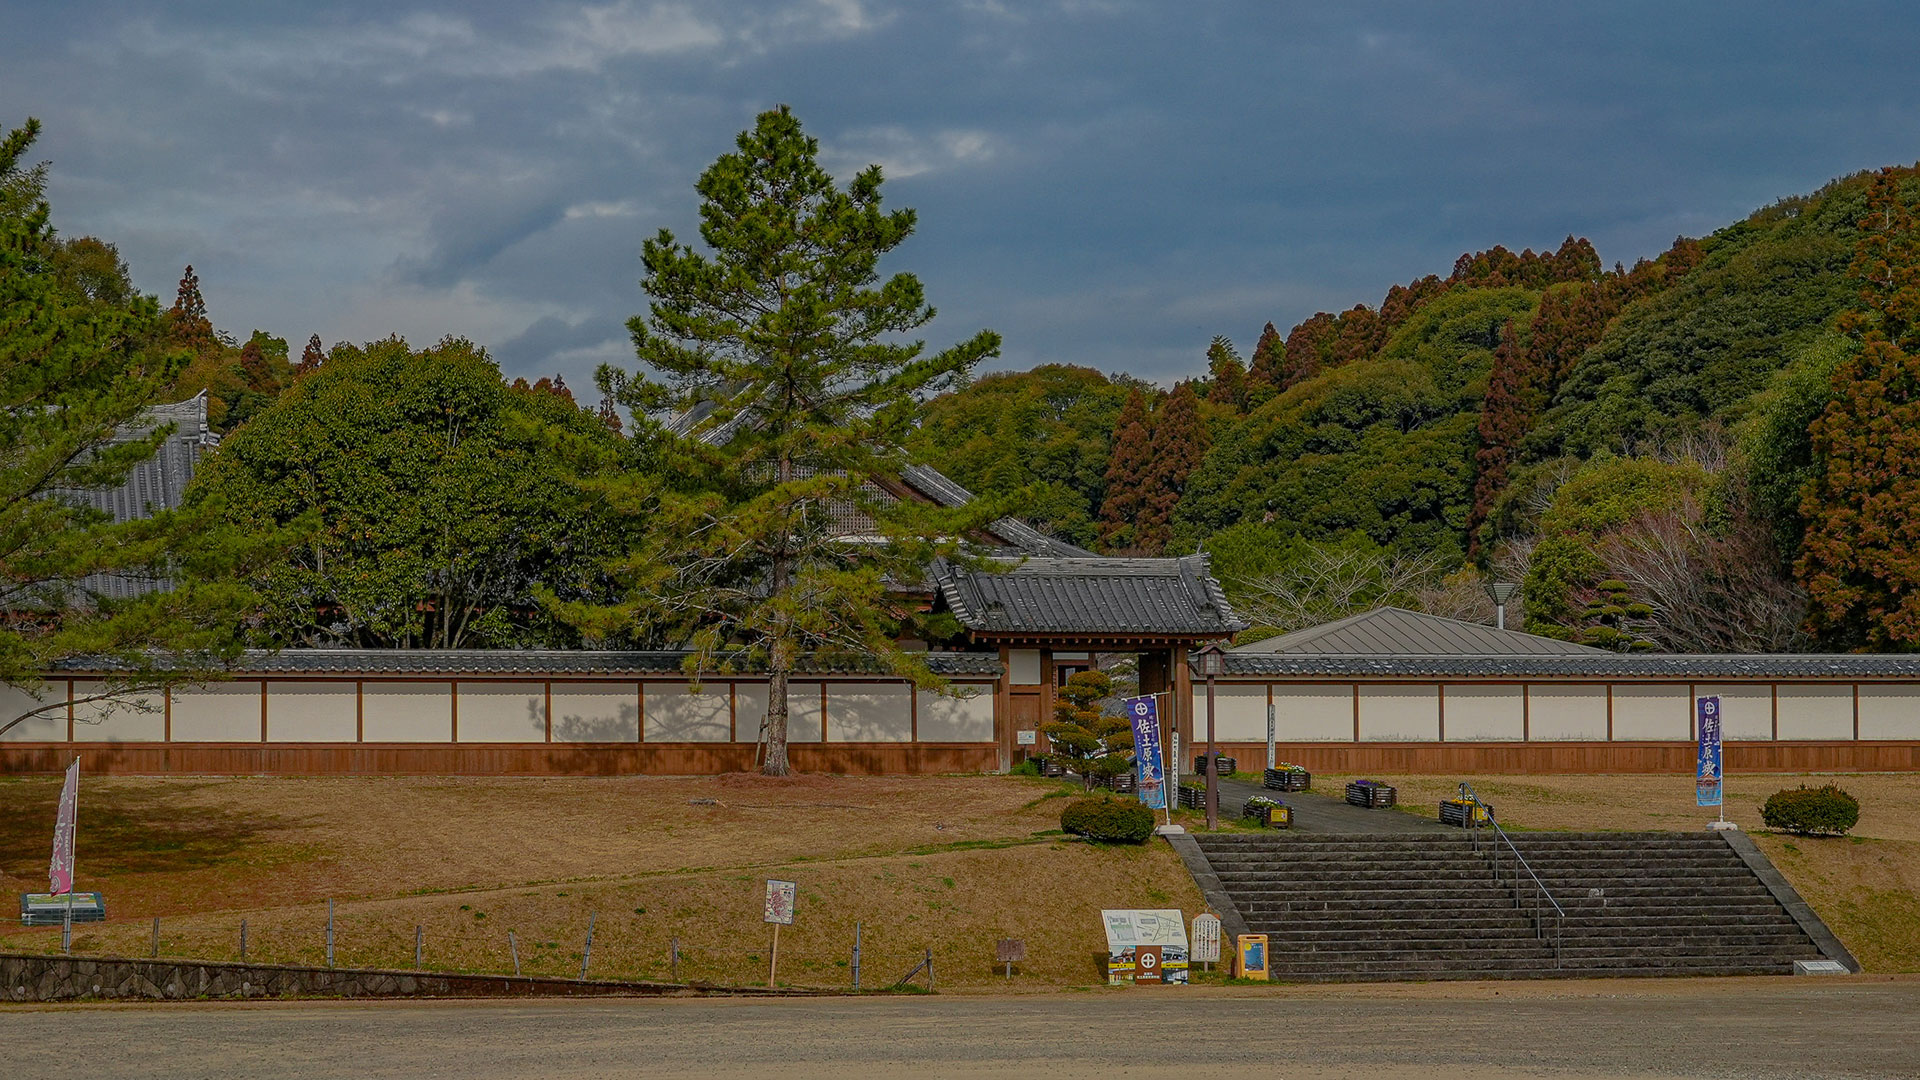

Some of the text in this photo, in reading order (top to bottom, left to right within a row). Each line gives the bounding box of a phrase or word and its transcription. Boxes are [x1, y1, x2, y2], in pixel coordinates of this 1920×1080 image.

[1136, 719, 1155, 777] 佐土原城
[1702, 718, 1715, 776] 佐土原城
